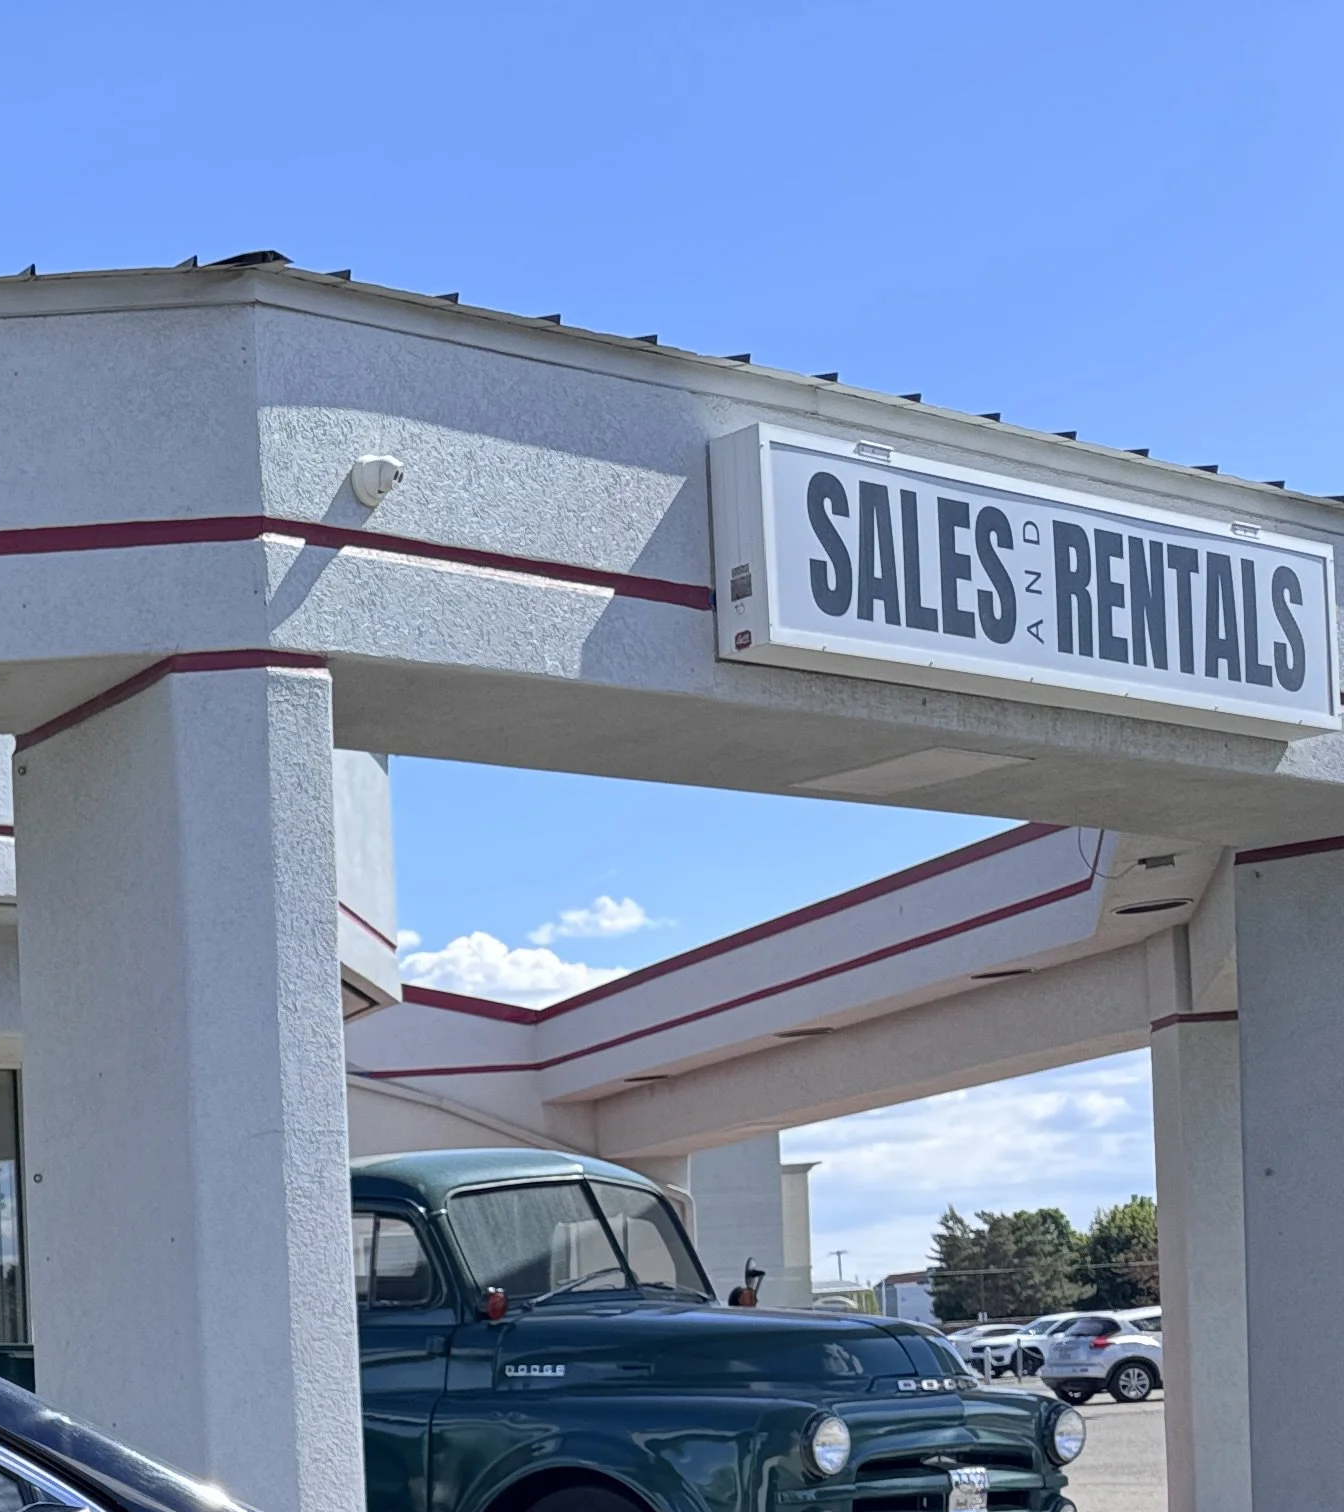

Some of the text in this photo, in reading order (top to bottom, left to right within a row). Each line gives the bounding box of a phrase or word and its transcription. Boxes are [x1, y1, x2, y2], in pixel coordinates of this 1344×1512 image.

[807, 471, 1306, 692] SALES AND RENTALS
